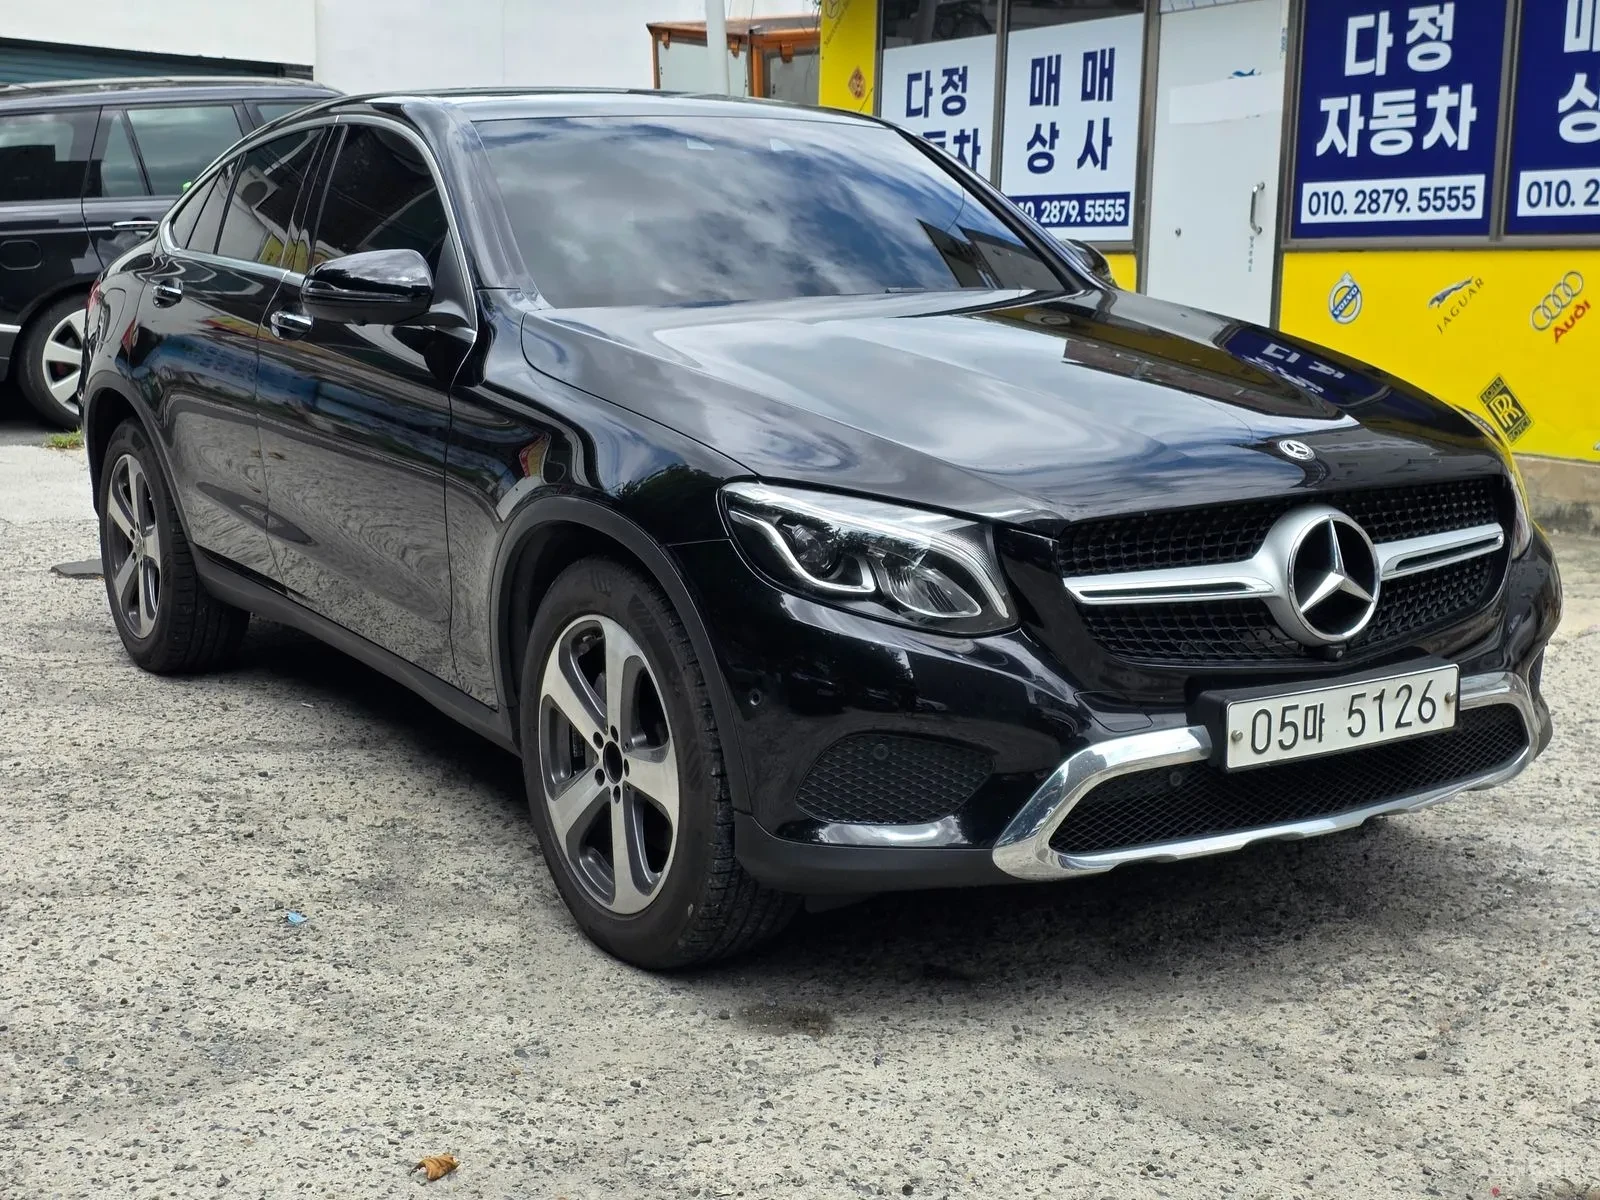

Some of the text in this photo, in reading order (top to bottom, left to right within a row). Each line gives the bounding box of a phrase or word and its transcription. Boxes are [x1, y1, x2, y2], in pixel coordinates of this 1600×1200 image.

[1345, 3, 1455, 76] 다정
[906, 66, 968, 118] 다정
[1316, 84, 1477, 157] 자동차
[1333, 286, 1358, 316] VOLVO
[1437, 278, 1484, 335] JAGUAR
[1554, 300, 1591, 344] Audi
[1251, 679, 1437, 755] 05마 5126
